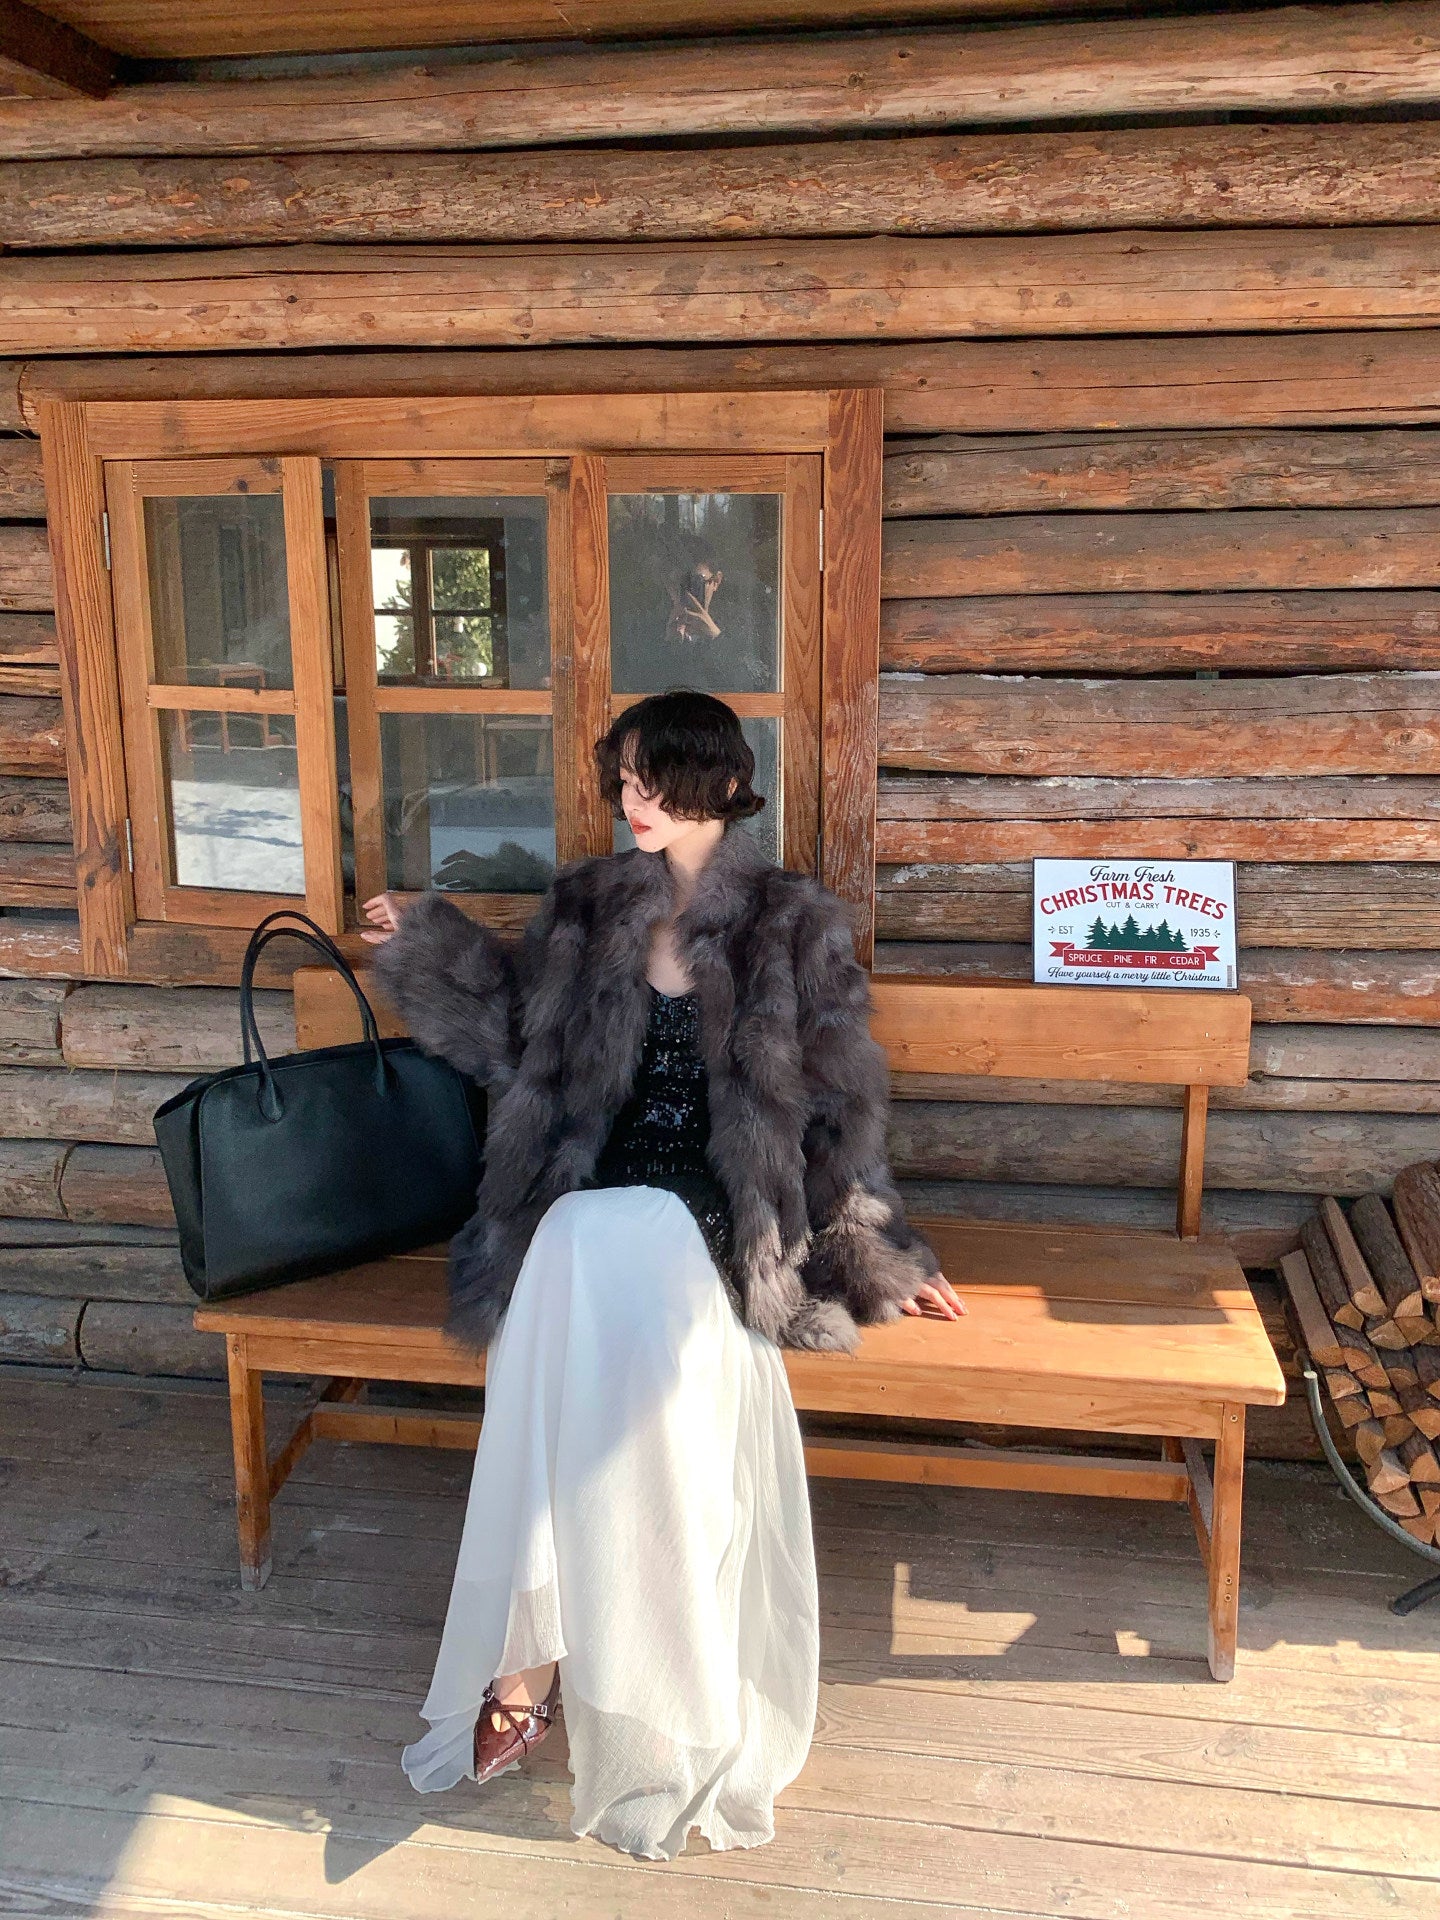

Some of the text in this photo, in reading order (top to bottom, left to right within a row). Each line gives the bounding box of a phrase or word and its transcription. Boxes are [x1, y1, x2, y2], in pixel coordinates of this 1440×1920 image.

[1090, 865, 1175, 882] Farm Fresh
[1040, 882, 1228, 919] CHRISTMAS TREES
[1058, 926, 1211, 937] EST 1935
[1068, 954, 1200, 965] SPRUCE PINE FIR CEDAR
[1047, 966, 1074, 978] Have
[1074, 970, 1111, 981] yourself
[1121, 972, 1149, 982] merry
[1150, 971, 1171, 980] little
[1172, 970, 1221, 982] Christmas
